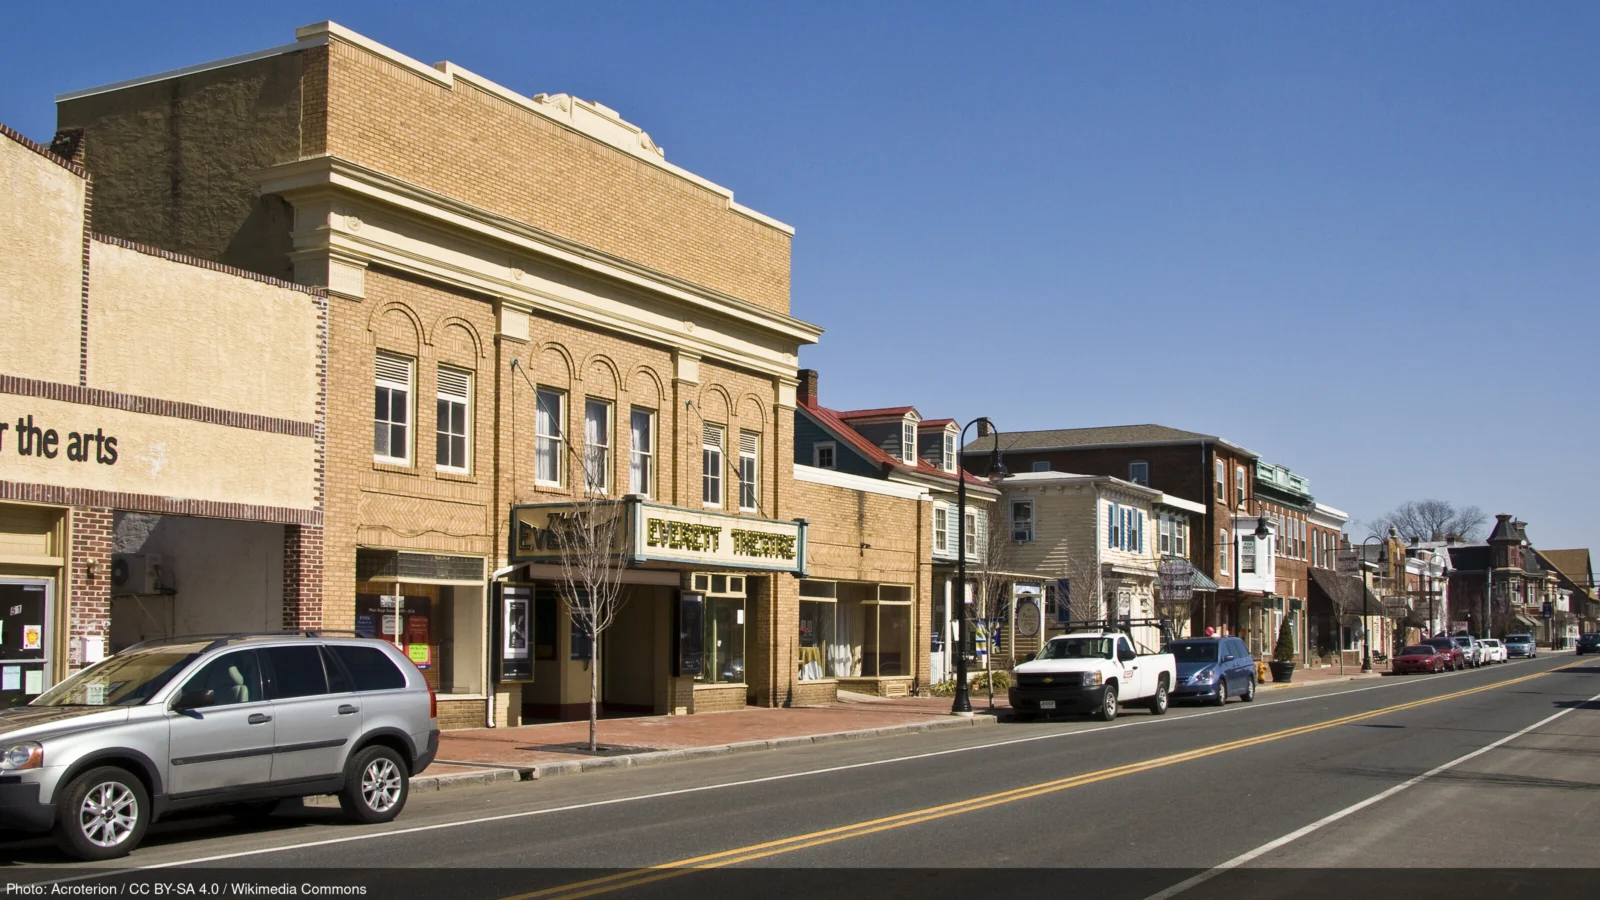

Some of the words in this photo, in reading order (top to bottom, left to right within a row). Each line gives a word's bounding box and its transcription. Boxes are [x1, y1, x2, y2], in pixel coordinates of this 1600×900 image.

[16, 415, 59, 459] the
[67, 428, 118, 465] arts
[647, 518, 722, 553] EVERETT
[731, 528, 796, 560] THEATRE
[11, 605, 21, 615] 51
